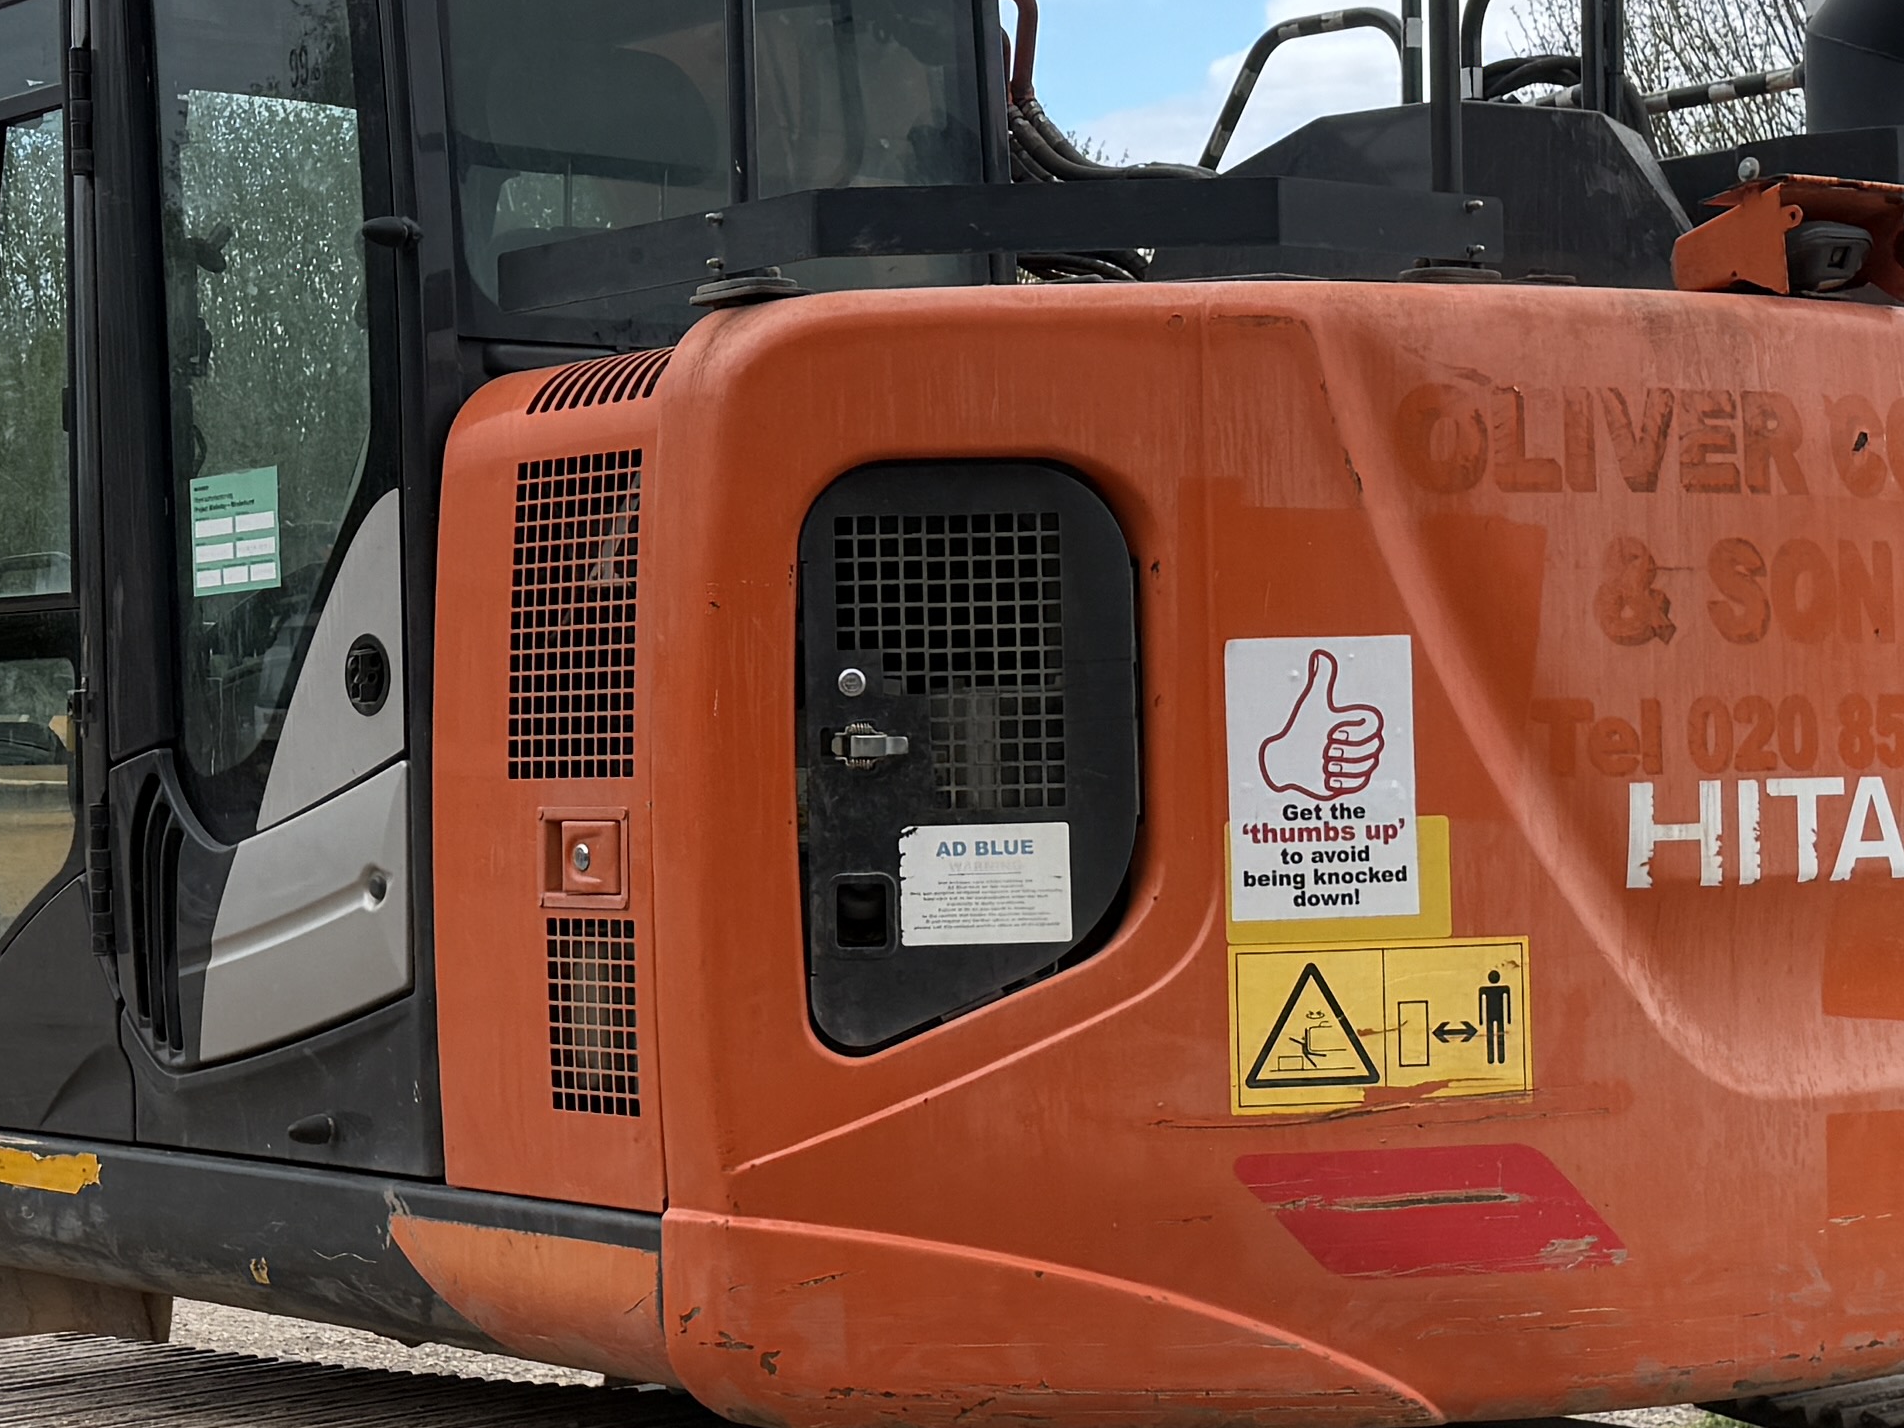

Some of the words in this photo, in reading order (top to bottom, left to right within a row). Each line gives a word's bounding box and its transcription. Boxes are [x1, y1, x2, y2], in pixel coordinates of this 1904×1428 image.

[1396, 383, 1810, 495] OLIVER
[1595, 536, 1677, 646] &
[1707, 537, 1895, 645] SON
[1530, 695, 1664, 777] Tel
[1688, 692, 1819, 772] 020
[1282, 803, 1322, 821] Get
[1330, 802, 1366, 820] the
[1242, 821, 1356, 844] 'thumbs
[1365, 817, 1405, 845] up'
[936, 841, 967, 858] AD
[975, 839, 1034, 856] BLUE
[1281, 848, 1303, 864] to
[1311, 845, 1370, 863] avoid
[1243, 870, 1306, 890] being
[1313, 865, 1408, 886] knocked
[1293, 888, 1360, 907] down!
